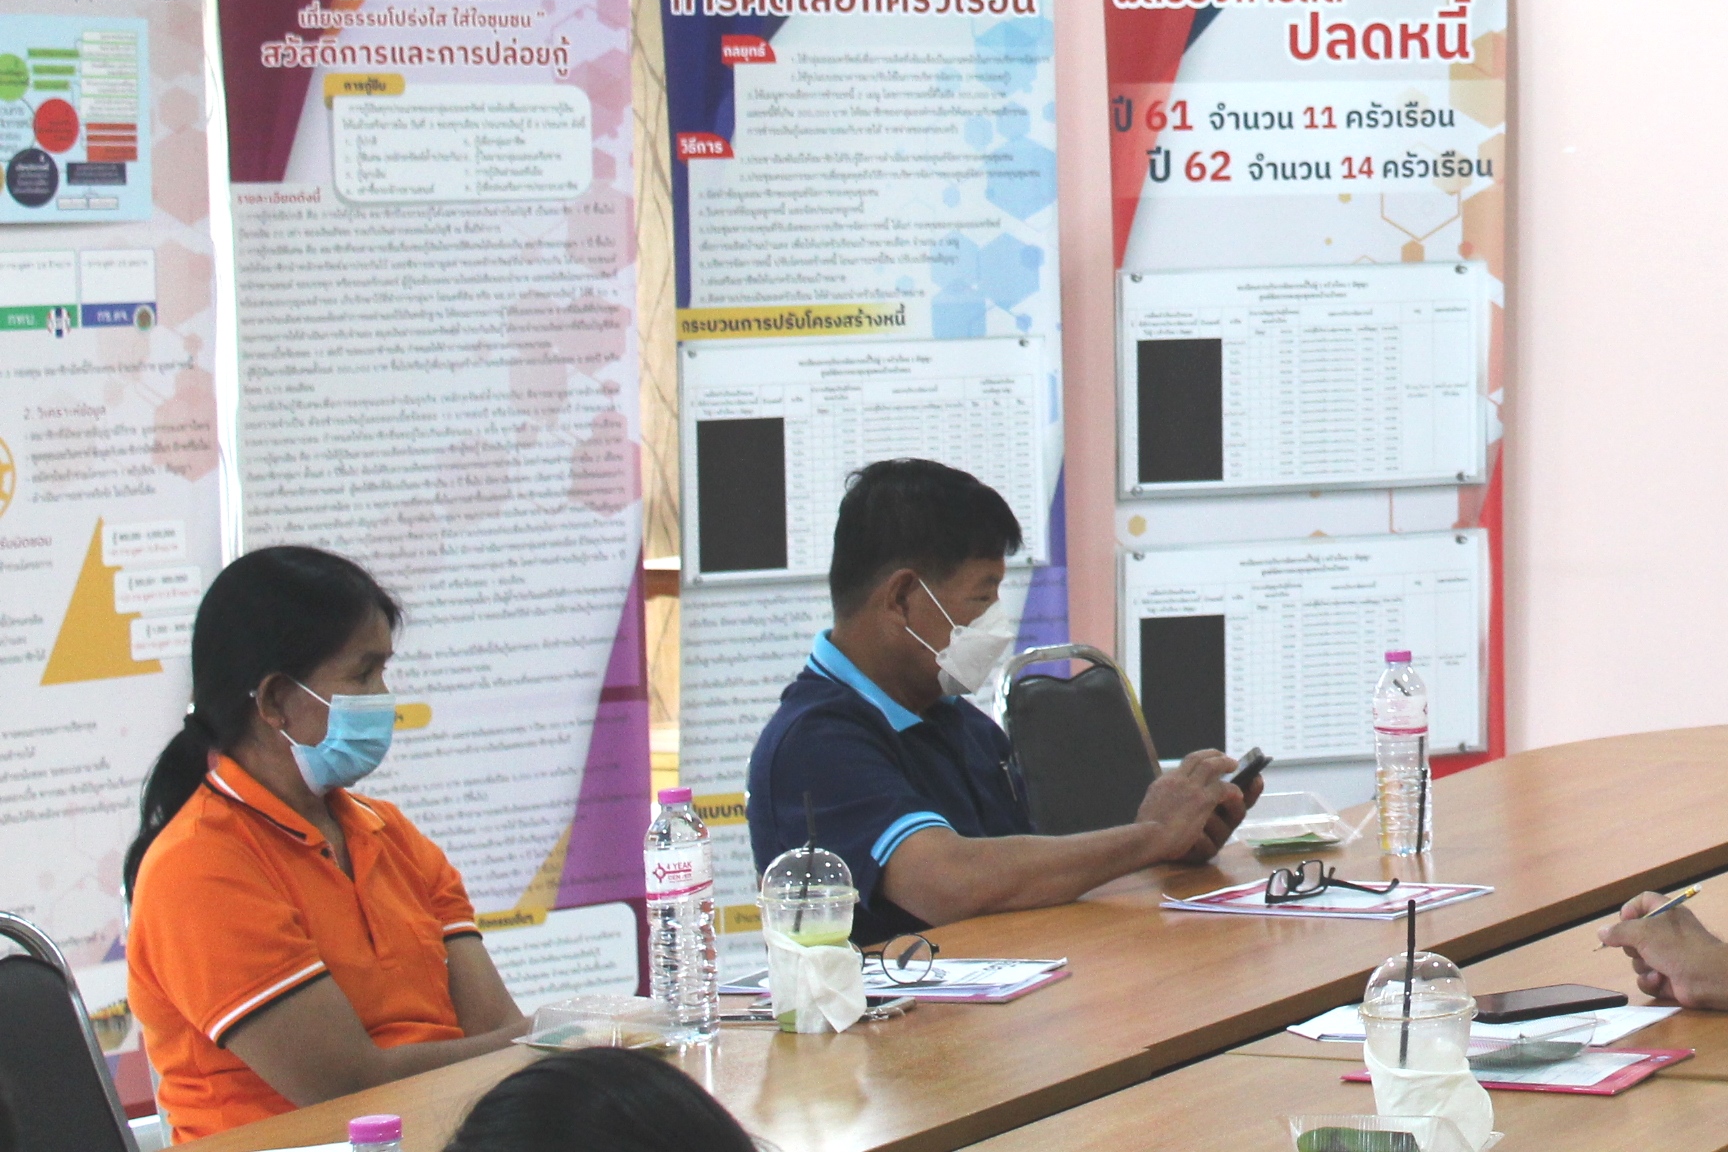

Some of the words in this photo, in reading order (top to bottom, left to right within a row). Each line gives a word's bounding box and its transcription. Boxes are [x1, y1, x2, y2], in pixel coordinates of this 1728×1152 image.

[263, 34, 570, 76] สวัสดิการและการปล่อยกู้
[1113, 95, 1133, 132] ปี
[1145, 99, 1194, 132] 61
[1209, 103, 1294, 130] จำนวน
[1303, 106, 1337, 129] 11
[1346, 101, 1456, 129] ครัวเรือน
[1147, 145, 1171, 183] ปี
[1184, 150, 1232, 182] 62
[1248, 155, 1332, 181] จำนวน
[1341, 156, 1374, 179] 14
[1383, 150, 1494, 179] ครัวเรือน
[682, 304, 906, 334] กระบวนการปรับโครงสร้างหนี้
